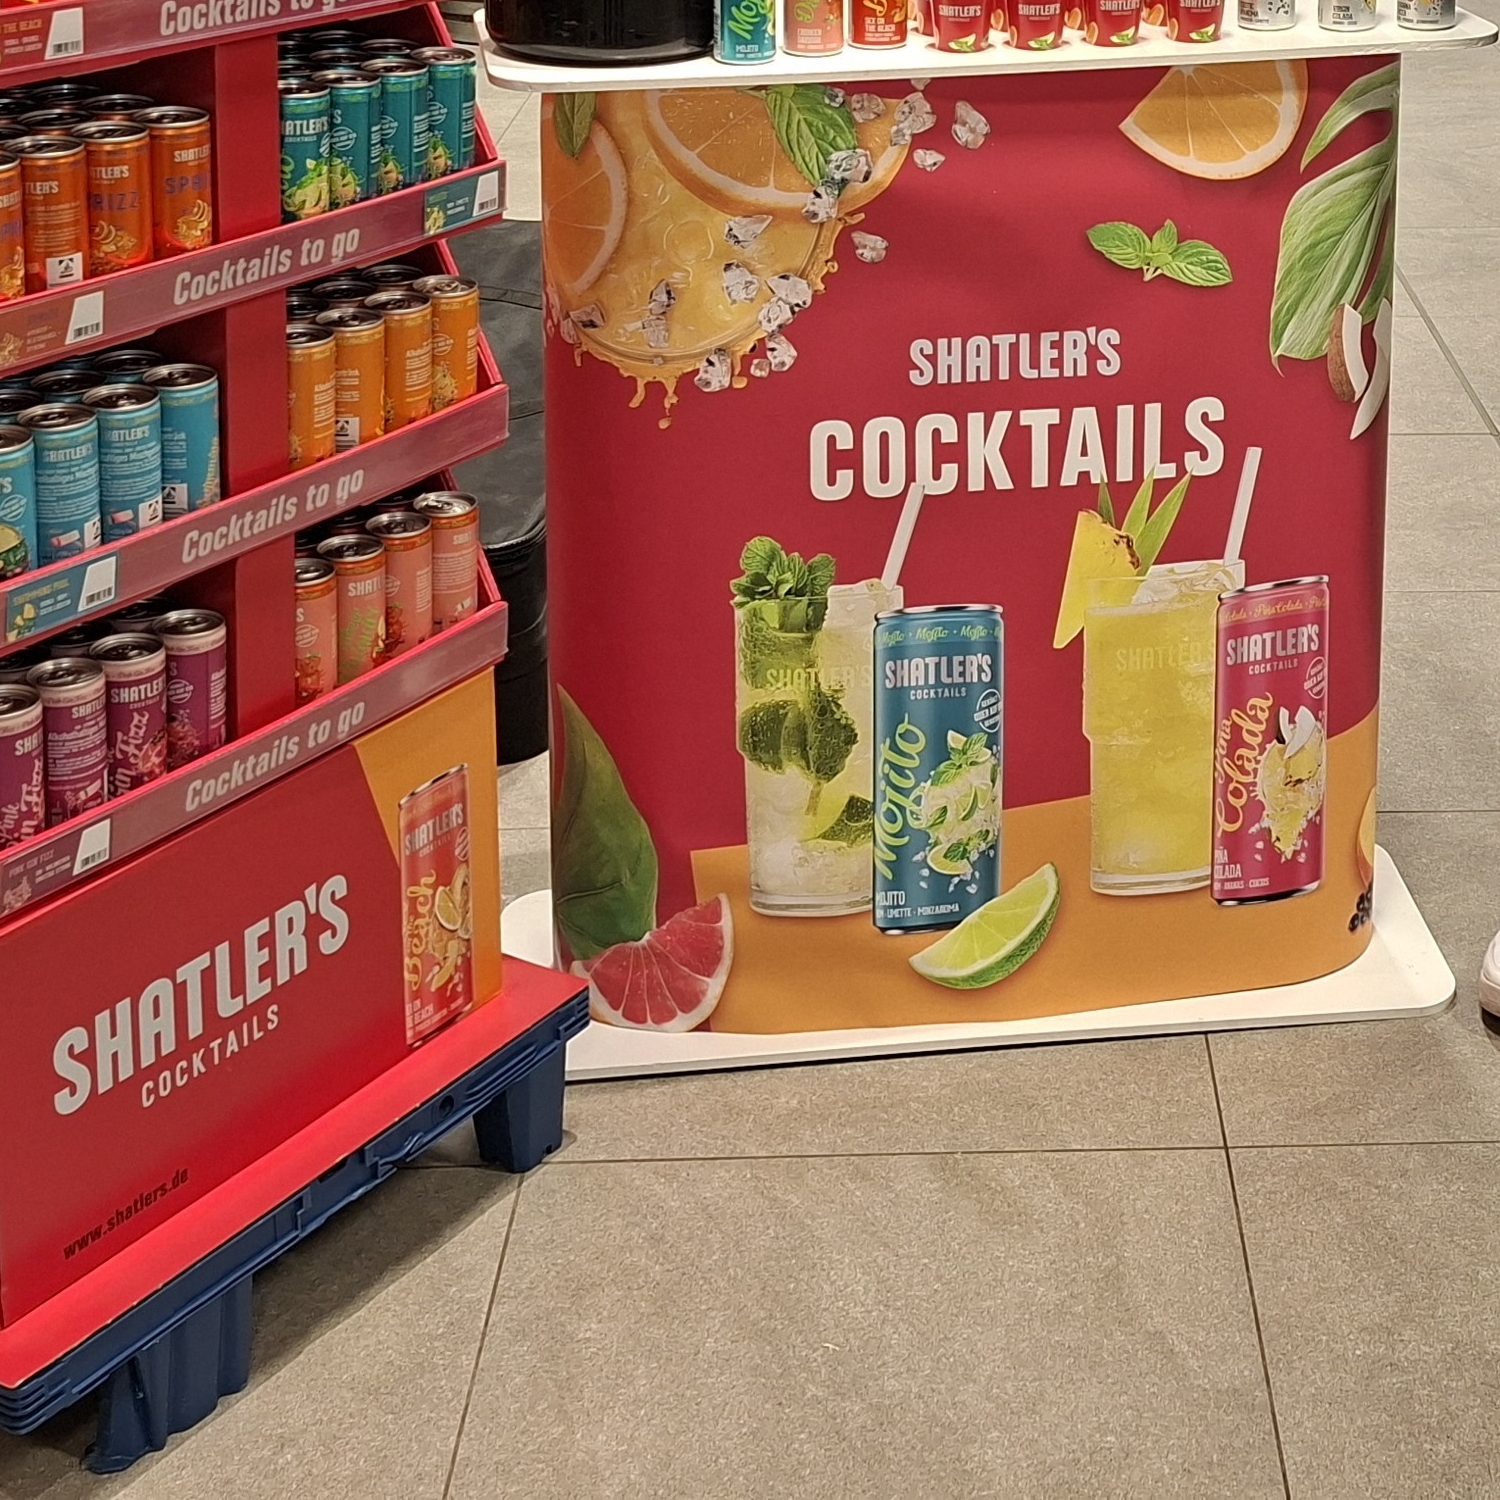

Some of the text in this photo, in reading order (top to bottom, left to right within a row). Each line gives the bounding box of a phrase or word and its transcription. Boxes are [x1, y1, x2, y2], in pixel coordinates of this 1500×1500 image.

[938, 3, 981, 17] SHATLER'S
[1018, 3, 1061, 16] SHATLER'S
[285, 116, 328, 135] ATLER'S
[173, 226, 361, 305] Cocktails to go
[908, 325, 1122, 387] SHATLER'S
[810, 396, 1225, 502] COCKTAILS
[181, 468, 365, 563] Cocktails to go
[915, 627, 949, 642] Mojito
[960, 625, 988, 641] Mojito
[1226, 624, 1319, 666] SHATLER'S
[111, 677, 165, 704] SHATLE
[885, 653, 992, 689] SHATLER'S
[1249, 658, 1298, 675] COCKTAILS
[910, 688, 967, 700] COCKTAILS
[185, 701, 366, 813] Cocktails to go
[1216, 691, 1273, 837] Colada
[874, 712, 931, 881] Mojito
[405, 803, 464, 856] SHATLER'S
[1215, 863, 1242, 879] OLADA
[52, 874, 350, 1116] SHATLER'S
[142, 1003, 280, 1108] COCKTAILS
[63, 1166, 190, 1261] www.shatlers.de
